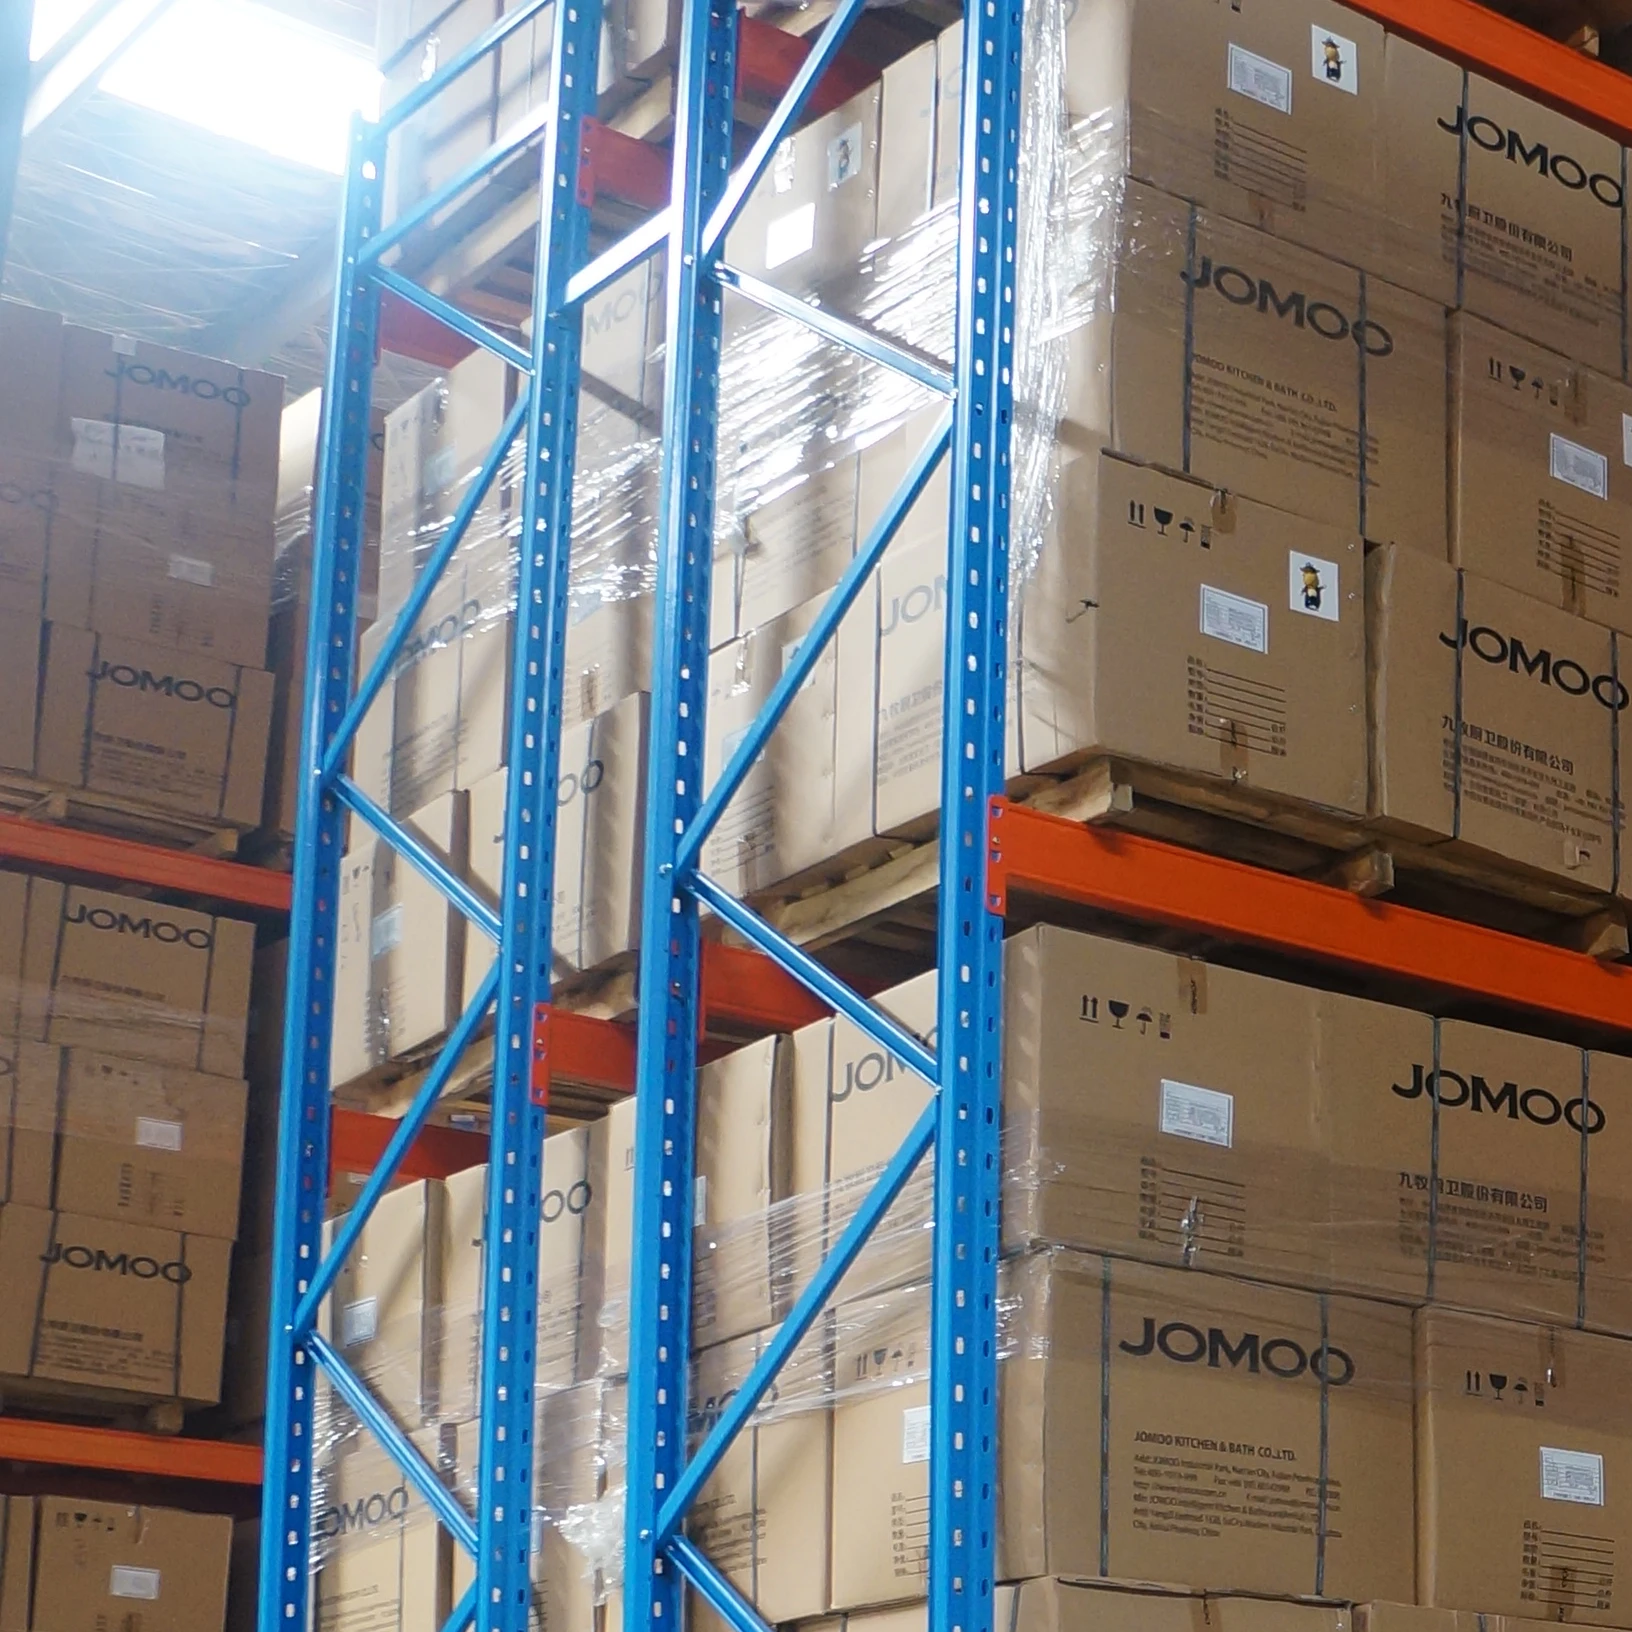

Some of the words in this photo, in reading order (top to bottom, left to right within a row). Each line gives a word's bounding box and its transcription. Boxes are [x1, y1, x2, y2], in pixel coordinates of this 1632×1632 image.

[1437, 104, 1626, 209] JOMOO
[1180, 256, 1396, 357] JOMOO
[106, 359, 252, 408] JOMOO
[90, 659, 237, 709] JOMOO
[1439, 619, 1630, 711] JOMOO
[63, 903, 212, 950] JOMOO
[1392, 1063, 1606, 1136] JOMOO
[40, 1242, 191, 1285] JOMOO
[1119, 1316, 1356, 1388] JOMOO
[1174, 1436, 1218, 1451] KITCHEN
[1228, 1442, 1256, 1456] BATH
[315, 1487, 409, 1539] OMOO
